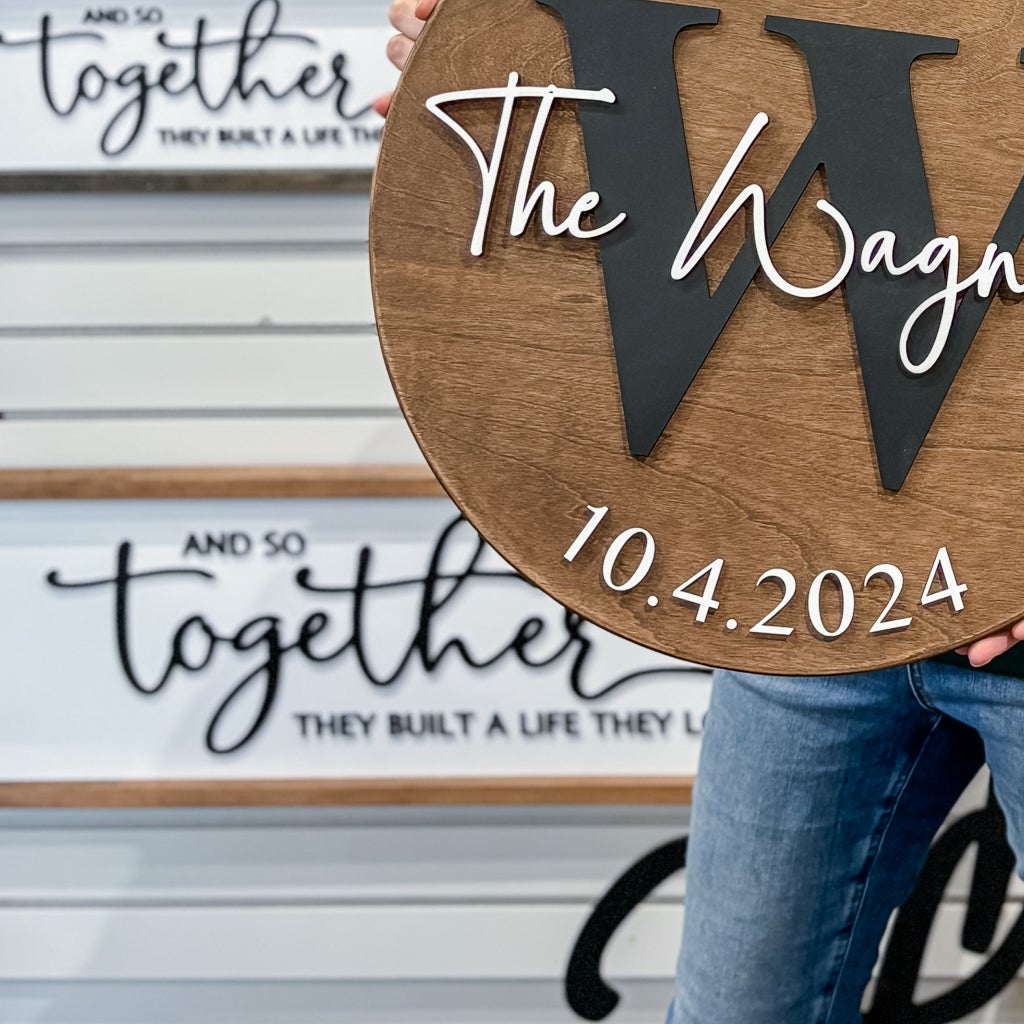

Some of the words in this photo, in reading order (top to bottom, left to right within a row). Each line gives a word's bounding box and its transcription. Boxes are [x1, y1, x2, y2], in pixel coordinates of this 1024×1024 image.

[83, 8, 129, 25] AND
[135, 8, 164, 25] SO
[157, 129, 209, 146] THEY
[218, 128, 273, 146] BUILT
[281, 128, 296, 145] A
[304, 127, 343, 145] LIFE
[425, 72, 627, 258] The
[181, 531, 252, 557] AND
[264, 531, 308, 557] SO
[562, 502, 969, 638] 10.4.2024
[47, 509, 714, 755] together
[293, 712, 375, 739] THEY
[388, 711, 475, 738] BUILT
[485, 711, 509, 737] A
[519, 711, 580, 737] LIFE
[591, 710, 673, 737] THEY
